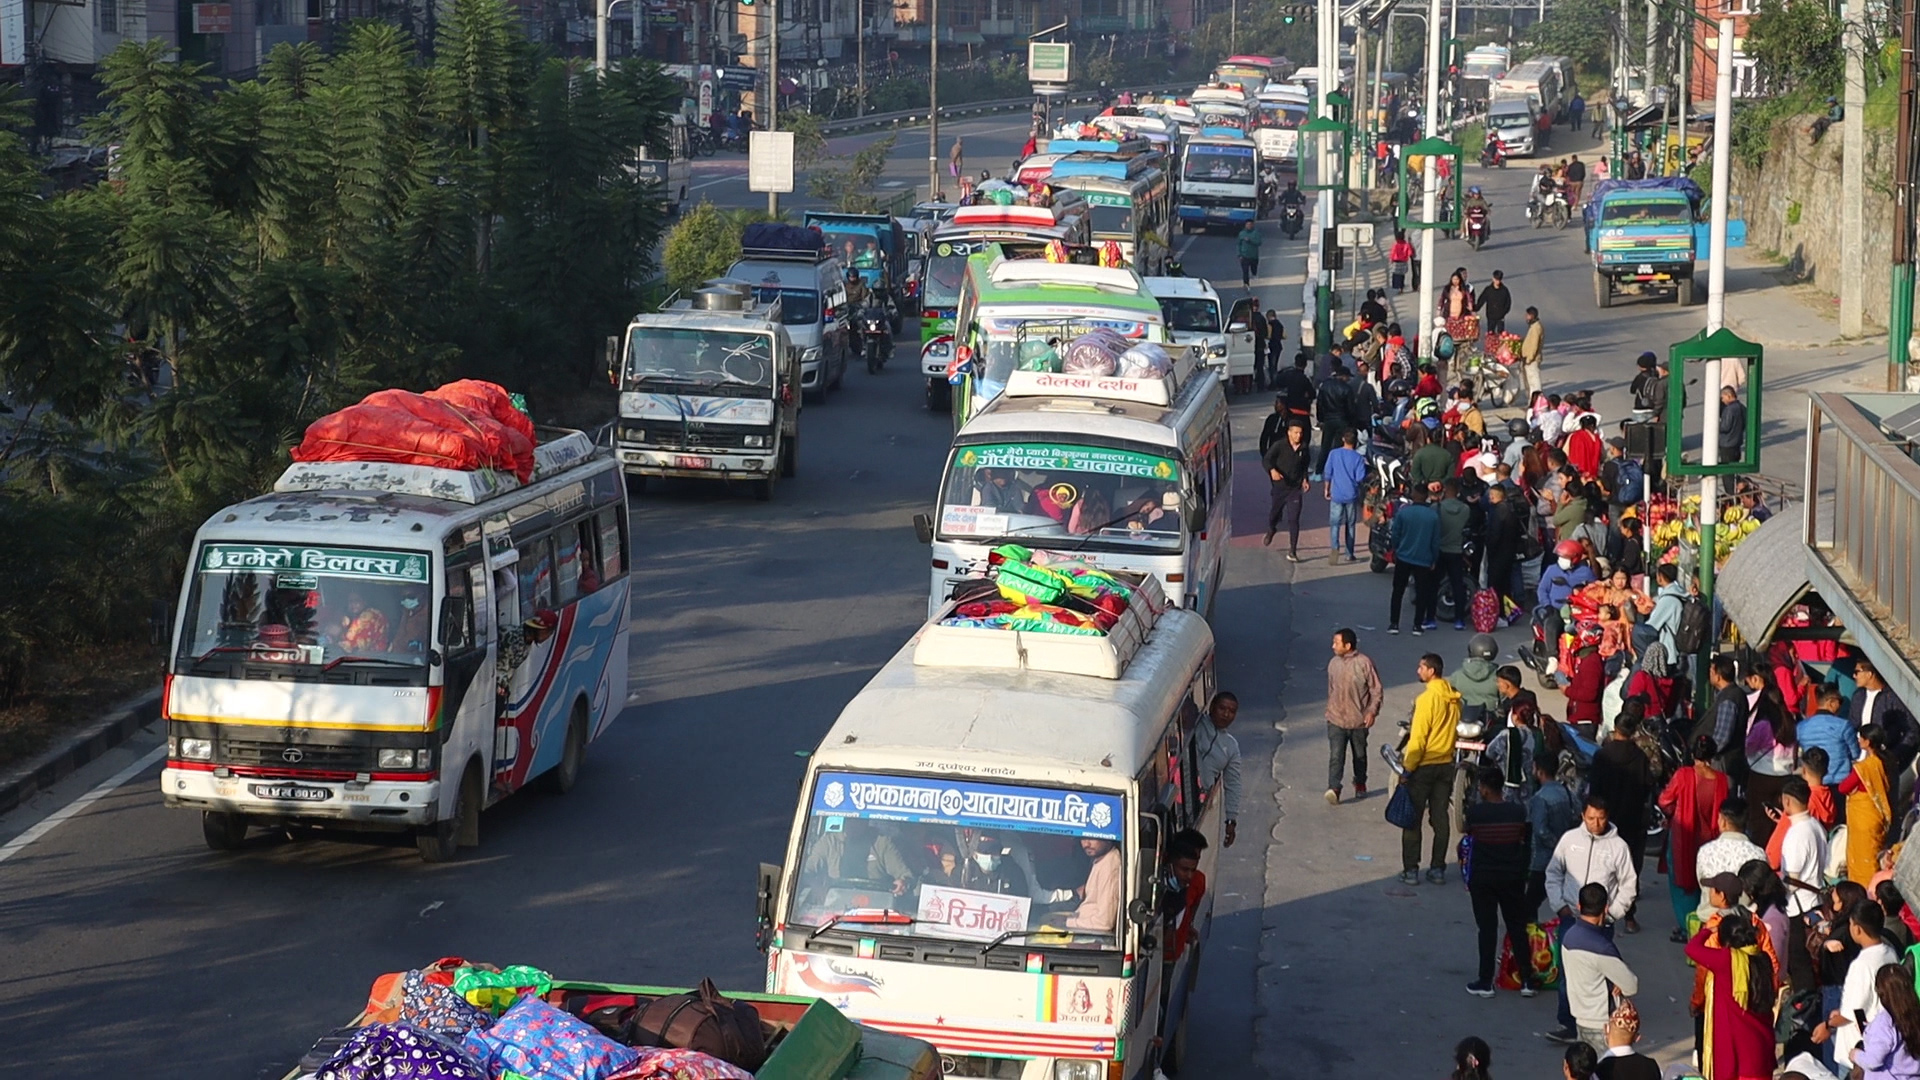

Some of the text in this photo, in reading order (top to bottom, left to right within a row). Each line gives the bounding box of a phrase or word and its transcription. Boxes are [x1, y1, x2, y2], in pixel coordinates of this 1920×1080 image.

[1036, 375, 1138, 391] दोलखा दर्शन
[1072, 459, 1154, 477] यातायात
[227, 547, 399, 574] चमेरो डिलक्स
[981, 766, 1016, 776] महादेव
[850, 782, 941, 810] शुभकामना
[943, 795, 962, 809] २०
[962, 791, 1041, 820] यातायात
